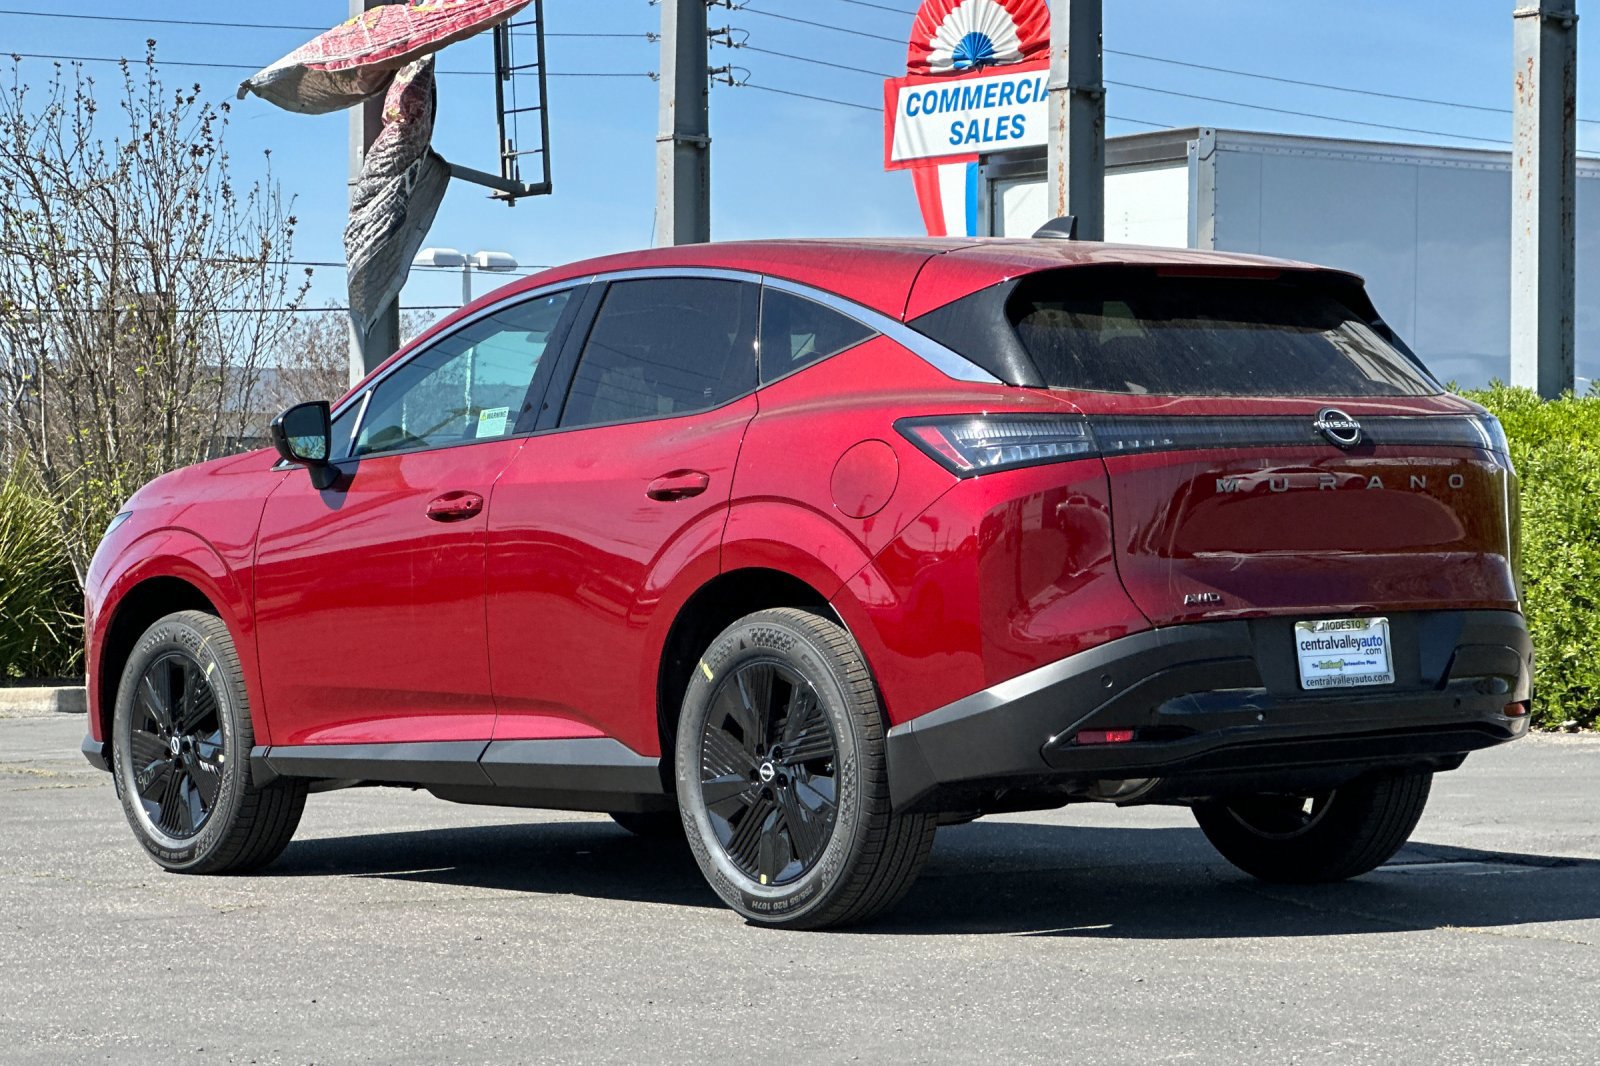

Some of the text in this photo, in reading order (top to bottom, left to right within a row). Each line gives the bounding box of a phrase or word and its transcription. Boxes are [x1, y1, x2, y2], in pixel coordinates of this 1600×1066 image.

[906, 77, 1050, 117] COMMERCI
[949, 114, 1026, 145] SALES
[1320, 421, 1361, 429] NISSAN
[1216, 473, 1465, 493] MURANO
[1183, 592, 1221, 605] AWD
[1322, 620, 1361, 631] MODESTO
[1300, 635, 1383, 652] centralvalleyauto
[1363, 647, 1382, 656] .com
[1306, 674, 1390, 687] centralvalleyauto.com
